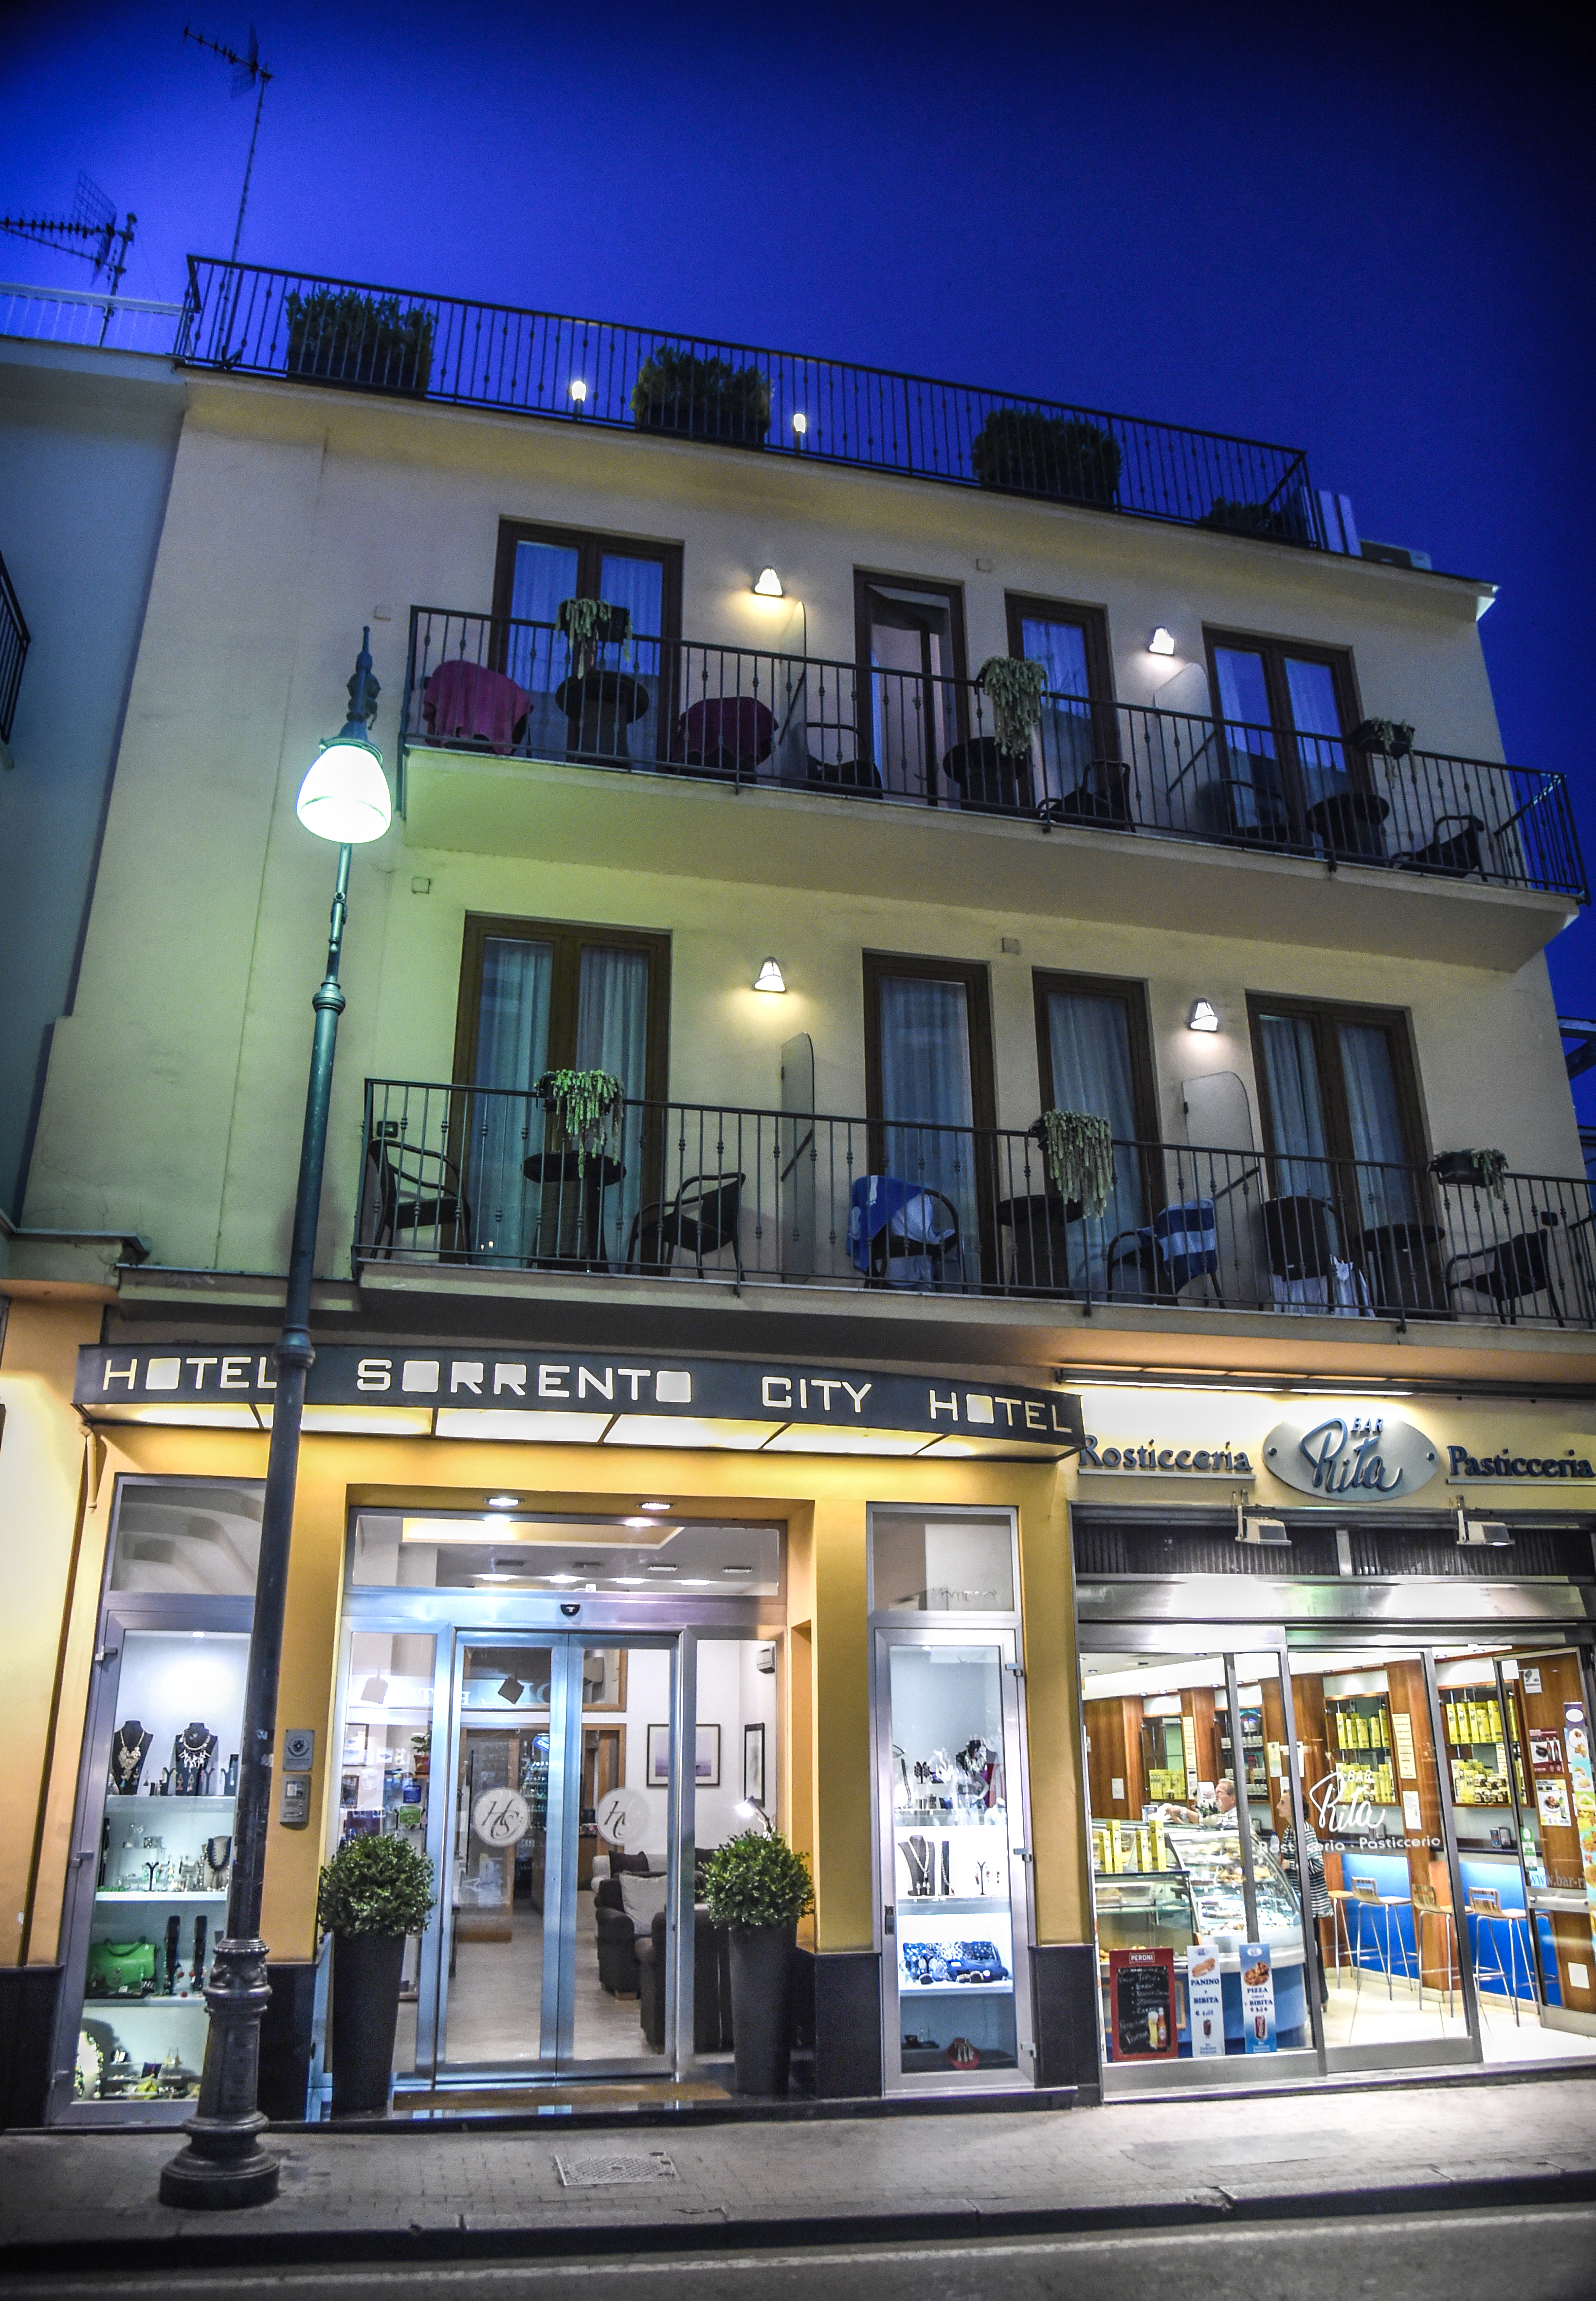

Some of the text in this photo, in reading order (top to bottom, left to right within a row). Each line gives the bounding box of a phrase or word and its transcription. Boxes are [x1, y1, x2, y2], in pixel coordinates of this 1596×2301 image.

[103, 1356, 1072, 1434] HOTEL SORRENTO CITY HOTEL
[1351, 1416, 1385, 1433] BAR
[1080, 1434, 1253, 1472] Rosticceria
[1300, 1417, 1403, 1493] Rita
[1446, 1445, 1595, 1478] Pasticceria
[1347, 1769, 1373, 1781] BAR
[1309, 1771, 1386, 1832] Rita
[1359, 1835, 1441, 1849] Pasticceria
